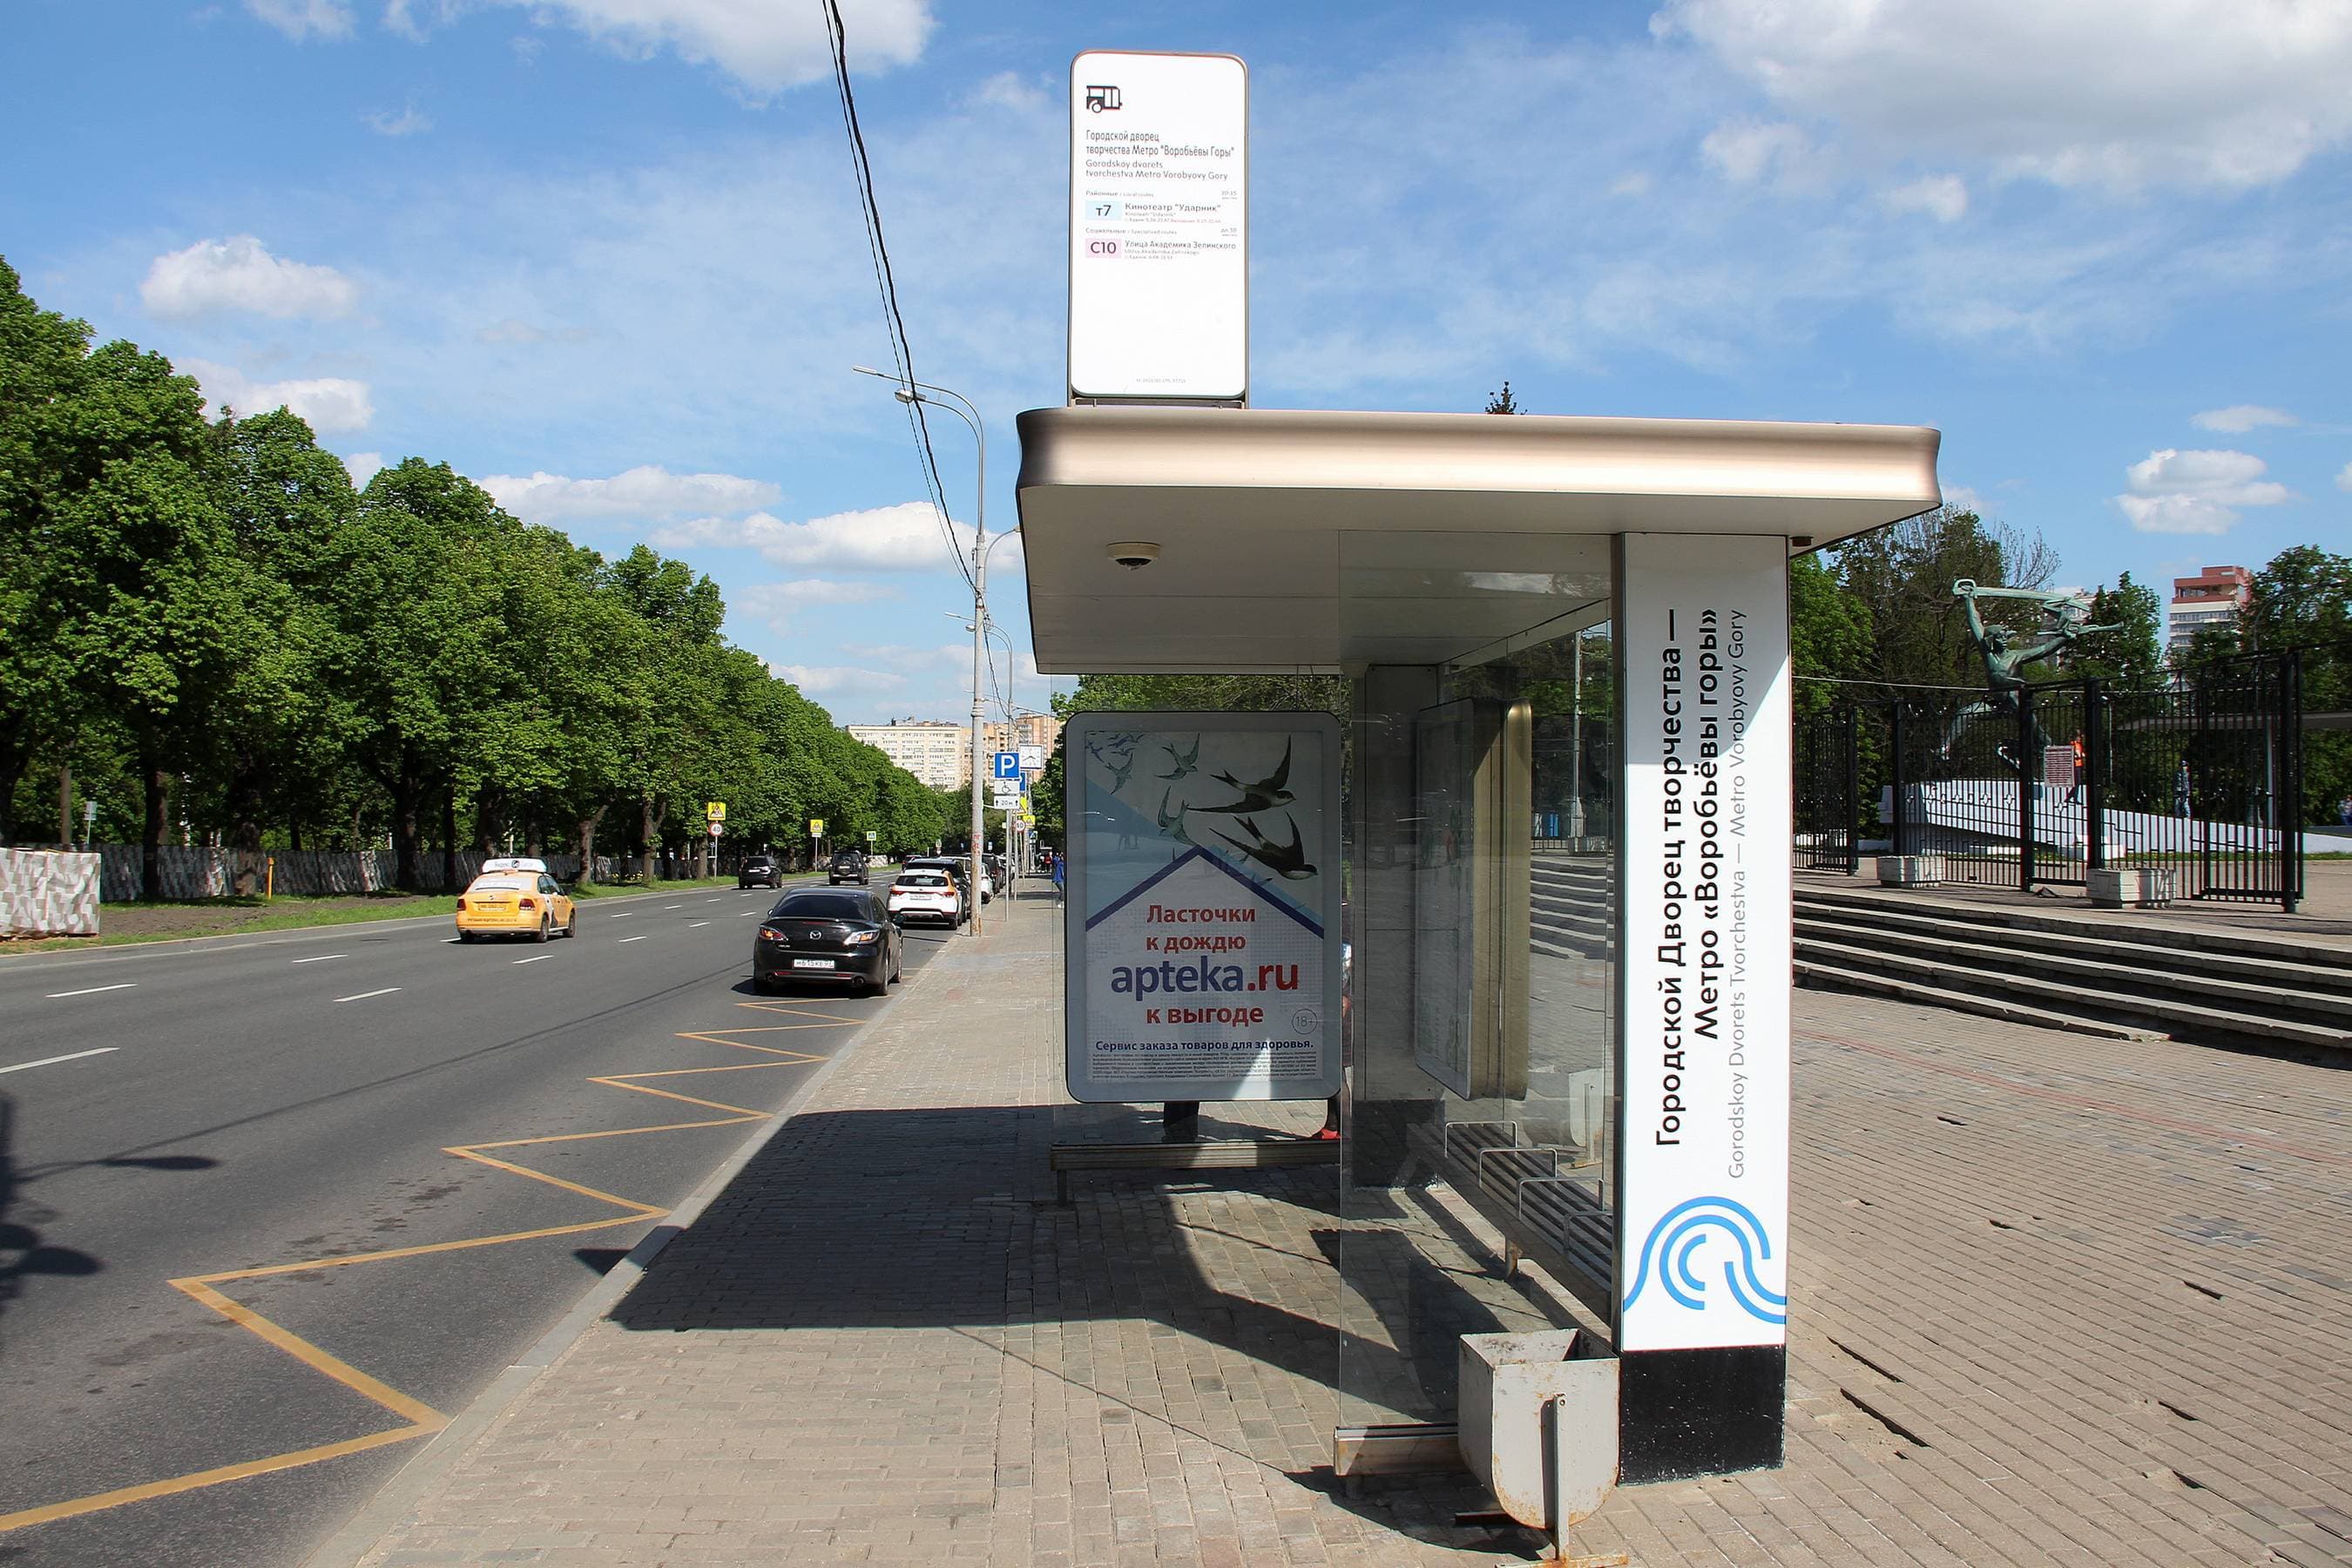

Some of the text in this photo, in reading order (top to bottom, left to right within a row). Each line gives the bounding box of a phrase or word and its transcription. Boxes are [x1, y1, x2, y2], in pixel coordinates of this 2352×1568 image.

[1085, 130, 1159, 143] Городской дворец
[1085, 145, 1130, 155] творчества
[1132, 146, 1159, 156] Метро
[1085, 159, 1163, 169] Gorodskoy dvorets
[1085, 169, 1133, 178] tvorchestva
[1163, 170, 1206, 181] Vorobyovy
[1208, 172, 1228, 182] Gory
[1125, 203, 1173, 213] Кинотеатр
[1150, 240, 1192, 249] Академика
[1727, 609, 1747, 659] Gory
[1662, 647, 1687, 832] творчества
[1727, 665, 1749, 768] Vorobyovy
[1693, 609, 1724, 1040] Метро «Воробьёвы горы»
[1729, 775, 1746, 836] Metro
[1146, 904, 1255, 923] Ласточки
[1658, 840, 1687, 967] Дворец
[1146, 936, 1247, 954] к дождю
[1729, 869, 1746, 987] Tvorchestva
[1111, 955, 1299, 1002] apteka.ru
[1146, 1006, 1264, 1027] к выгоде
[1729, 991, 1747, 1066] Dvorets
[1096, 1040, 1314, 1052] Сервис заказа товаров для здоровья.
[1656, 977, 1686, 1146] Городской
[1727, 1071, 1749, 1179] Gorodskoy
